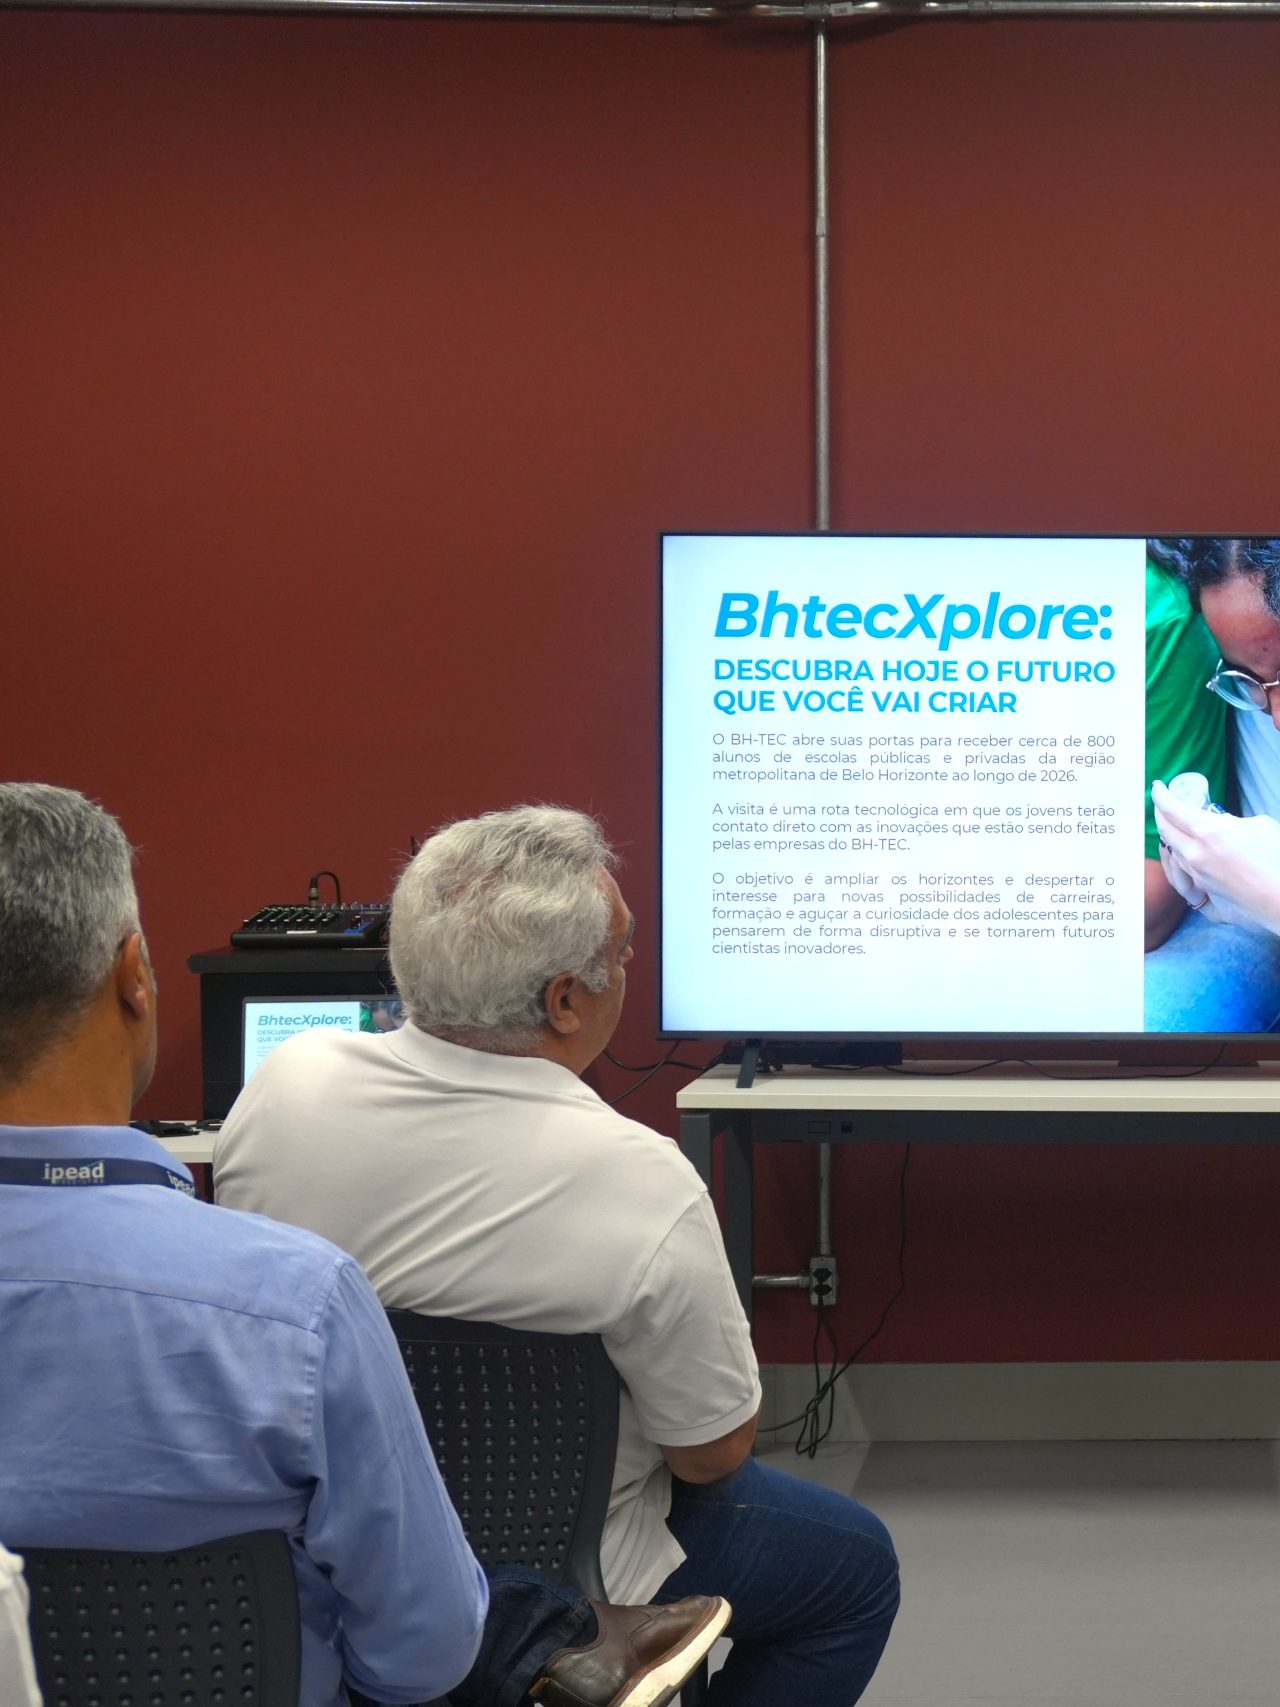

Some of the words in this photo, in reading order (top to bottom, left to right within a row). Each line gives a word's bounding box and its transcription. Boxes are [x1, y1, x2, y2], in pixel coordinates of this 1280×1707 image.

[714, 590, 1113, 652] BhtecXplore:
[715, 658, 875, 681] DESCUBRA
[883, 660, 959, 682] HOJE
[967, 660, 989, 682] O
[998, 661, 1116, 683] FUTURO
[713, 690, 775, 715] QUE
[783, 686, 864, 712] VOCÊ
[872, 691, 920, 712] VAI
[928, 691, 1017, 713] CRIAR
[713, 733, 724, 745] O
[731, 733, 786, 745] BH-TEC
[792, 733, 825, 745] abre
[830, 737, 862, 746] suas
[869, 736, 914, 749] portas
[921, 737, 951, 749] para
[958, 734, 1013, 746] receber
[1019, 738, 1057, 747] cerca
[1063, 735, 1081, 747] de
[1087, 736, 1115, 747] 800
[713, 750, 760, 763] alunos
[774, 751, 791, 763] de
[805, 751, 857, 763] escolas
[870, 751, 930, 766] públicas
[944, 755, 952, 763] e
[965, 752, 1025, 767] privadas
[1039, 752, 1056, 764] da
[1071, 752, 1115, 767] região
[712, 768, 815, 783] metropolitana
[820, 768, 838, 780] de
[843, 769, 874, 781] Belo
[879, 769, 948, 781] Horizonte
[952, 772, 969, 781] ao
[974, 769, 1014, 784] longo
[1018, 770, 1036, 781] de
[1041, 770, 1077, 782] 2026.
[712, 803, 723, 815] A
[728, 802, 764, 815] visita
[769, 803, 778, 815] é
[783, 806, 816, 815] uma
[822, 805, 849, 815] rota
[854, 803, 938, 819] tecnológica
[944, 807, 967, 815] em
[973, 807, 1000, 819] que
[1006, 807, 1022, 816] os
[1025, 804, 1072, 819] jovens
[1077, 805, 1114, 816] terão
[712, 822, 768, 832] contato
[773, 820, 815, 832] direto
[820, 824, 851, 832] com
[857, 824, 872, 832] as
[877, 820, 948, 836] inovações
[952, 824, 980, 836] que
[985, 822, 1023, 833] estão
[1028, 821, 1072, 834] sendo
[1076, 821, 1115, 834] feitas
[713, 837, 750, 852] pelas
[754, 841, 825, 853] empresas
[828, 838, 847, 850] do
[852, 838, 909, 850] BH-TEC.
[713, 872, 724, 884] O
[736, 872, 793, 887] objetivo
[805, 873, 813, 884] é
[824, 873, 879, 887] ampliar
[892, 876, 907, 885] os
[919, 873, 994, 885] horizontes
[1005, 876, 1014, 885] e
[1025, 874, 1094, 888] despertar
[1106, 877, 1114, 885] o
[713, 889, 777, 902] interesse
[794, 893, 825, 904] para
[842, 893, 884, 902] novas
[900, 890, 1000, 905] possibilidades
[1016, 891, 1034, 903] de
[1051, 891, 1114, 905] carreiras,
[712, 907, 781, 923] formação
[786, 911, 794, 919] e
[799, 910, 848, 923] aguçar
[853, 911, 861, 919] a
[866, 907, 949, 920] curiosidade
[953, 908, 979, 920] dos
[984, 908, 1078, 920] adolescentes
[1083, 912, 1113, 923] para
[713, 927, 785, 939] pensarem
[793, 925, 812, 936] de
[819, 925, 861, 936] forma
[870, 925, 940, 940] disruptiva
[948, 928, 957, 937] e
[964, 928, 980, 937] se
[987, 927, 1055, 938] tornarem
[1062, 926, 1114, 938] futuros
[712, 942, 780, 954] cientistas
[785, 942, 865, 954] inovadores.
[258, 1014, 352, 1027] BhtecXplore:
[44, 1162, 104, 1184] ipead
